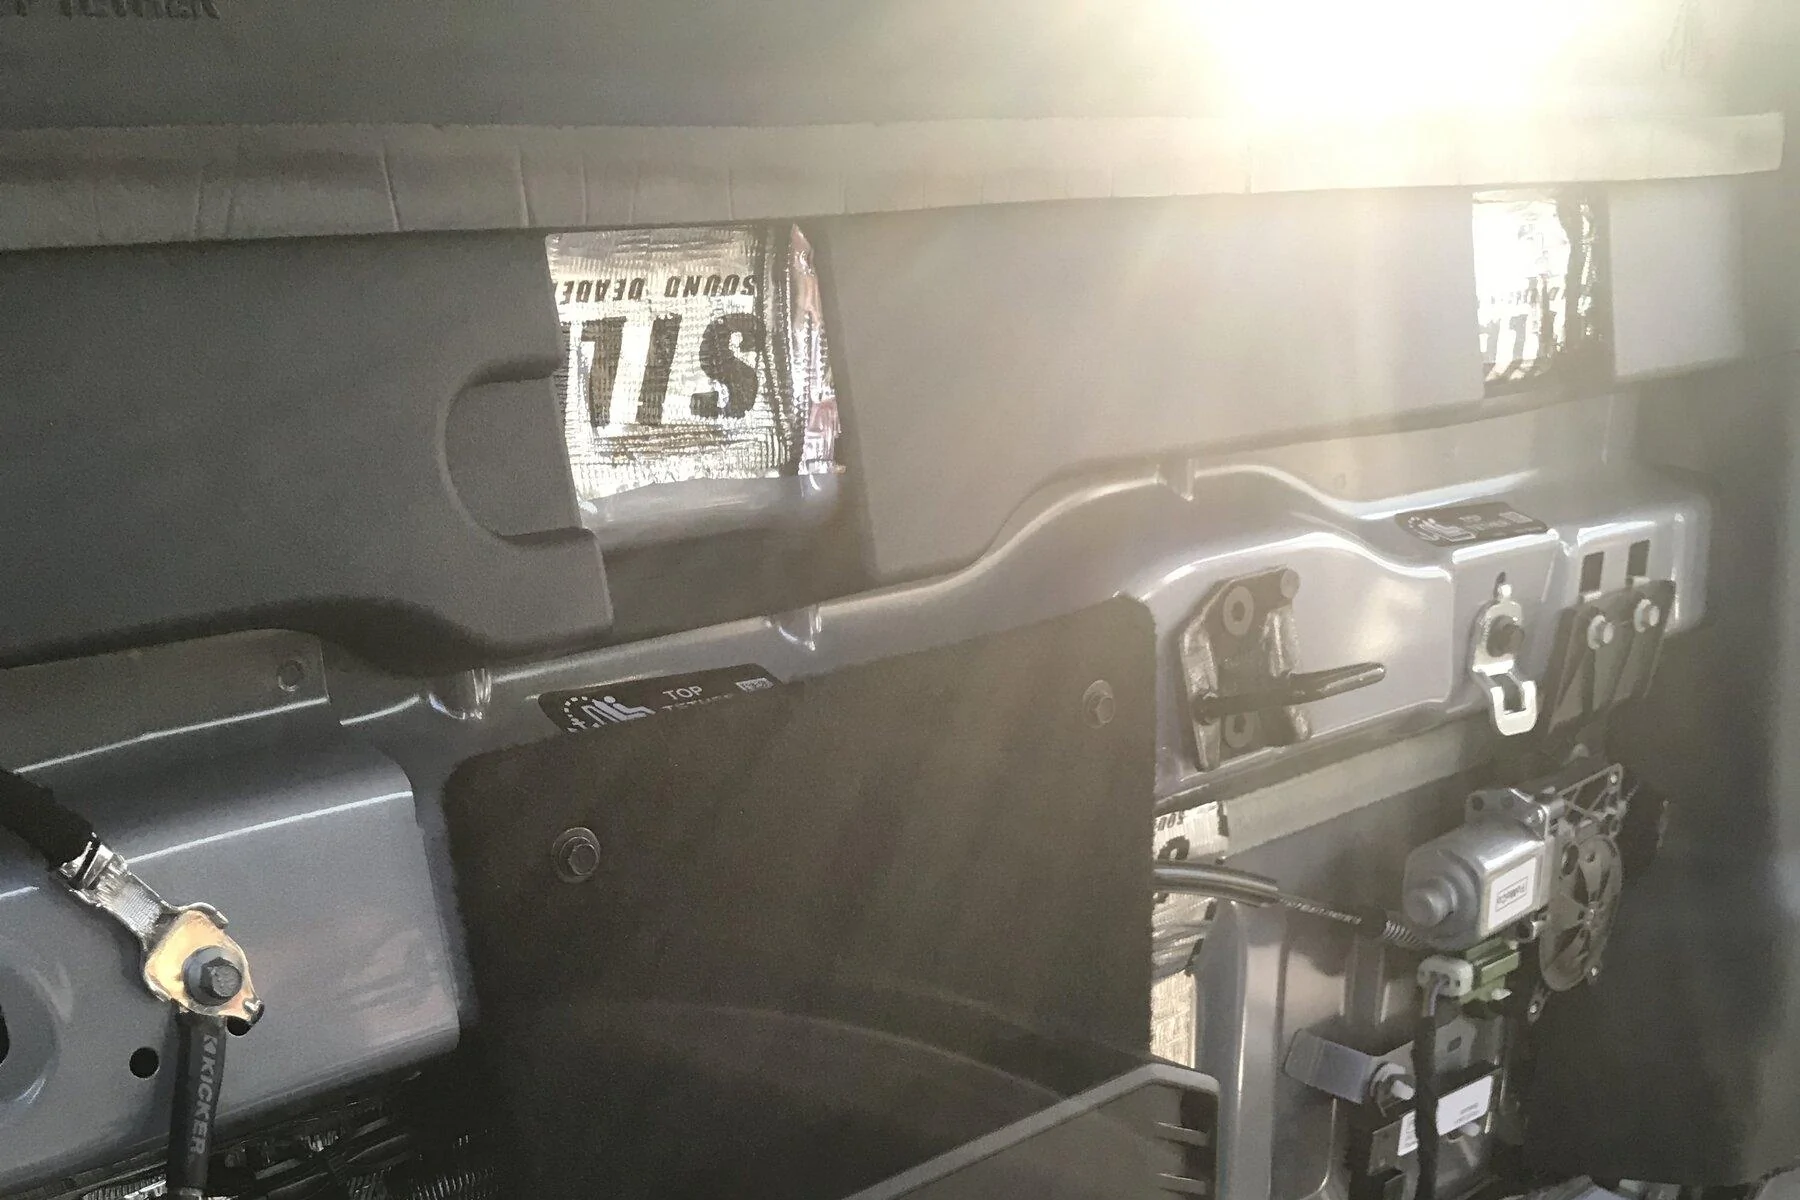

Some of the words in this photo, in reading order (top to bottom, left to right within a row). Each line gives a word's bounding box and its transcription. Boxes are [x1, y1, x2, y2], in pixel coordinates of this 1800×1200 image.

[556, 279, 646, 304] DEADE
[664, 274, 757, 297] SOUND
[580, 312, 767, 428] SIL
[662, 685, 703, 700] TOP
[190, 1033, 218, 1154] KICKER
